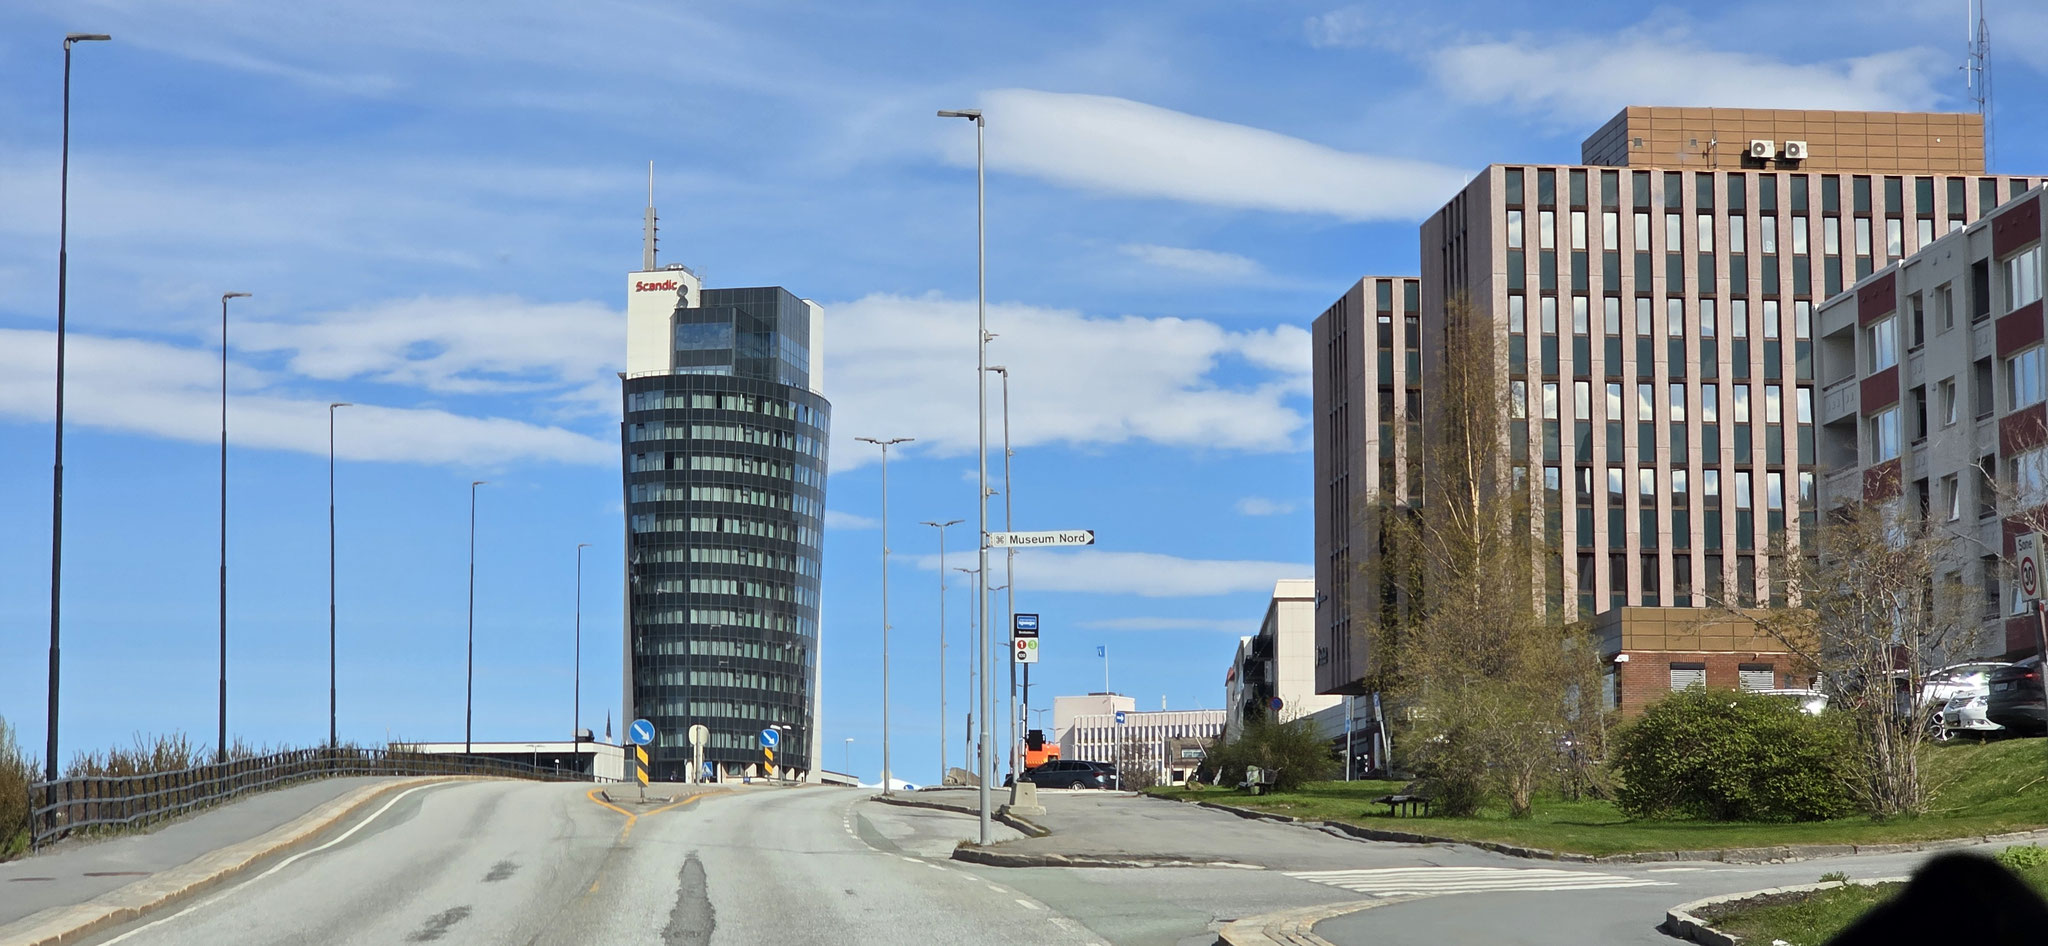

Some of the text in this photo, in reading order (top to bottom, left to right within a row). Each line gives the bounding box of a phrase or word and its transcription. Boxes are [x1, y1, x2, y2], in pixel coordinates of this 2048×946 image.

[635, 280, 677, 292] Scandic
[1009, 533, 1085, 544] Museum Nord
[2018, 539, 2033, 551] Sone
[2024, 566, 2034, 586] 30
